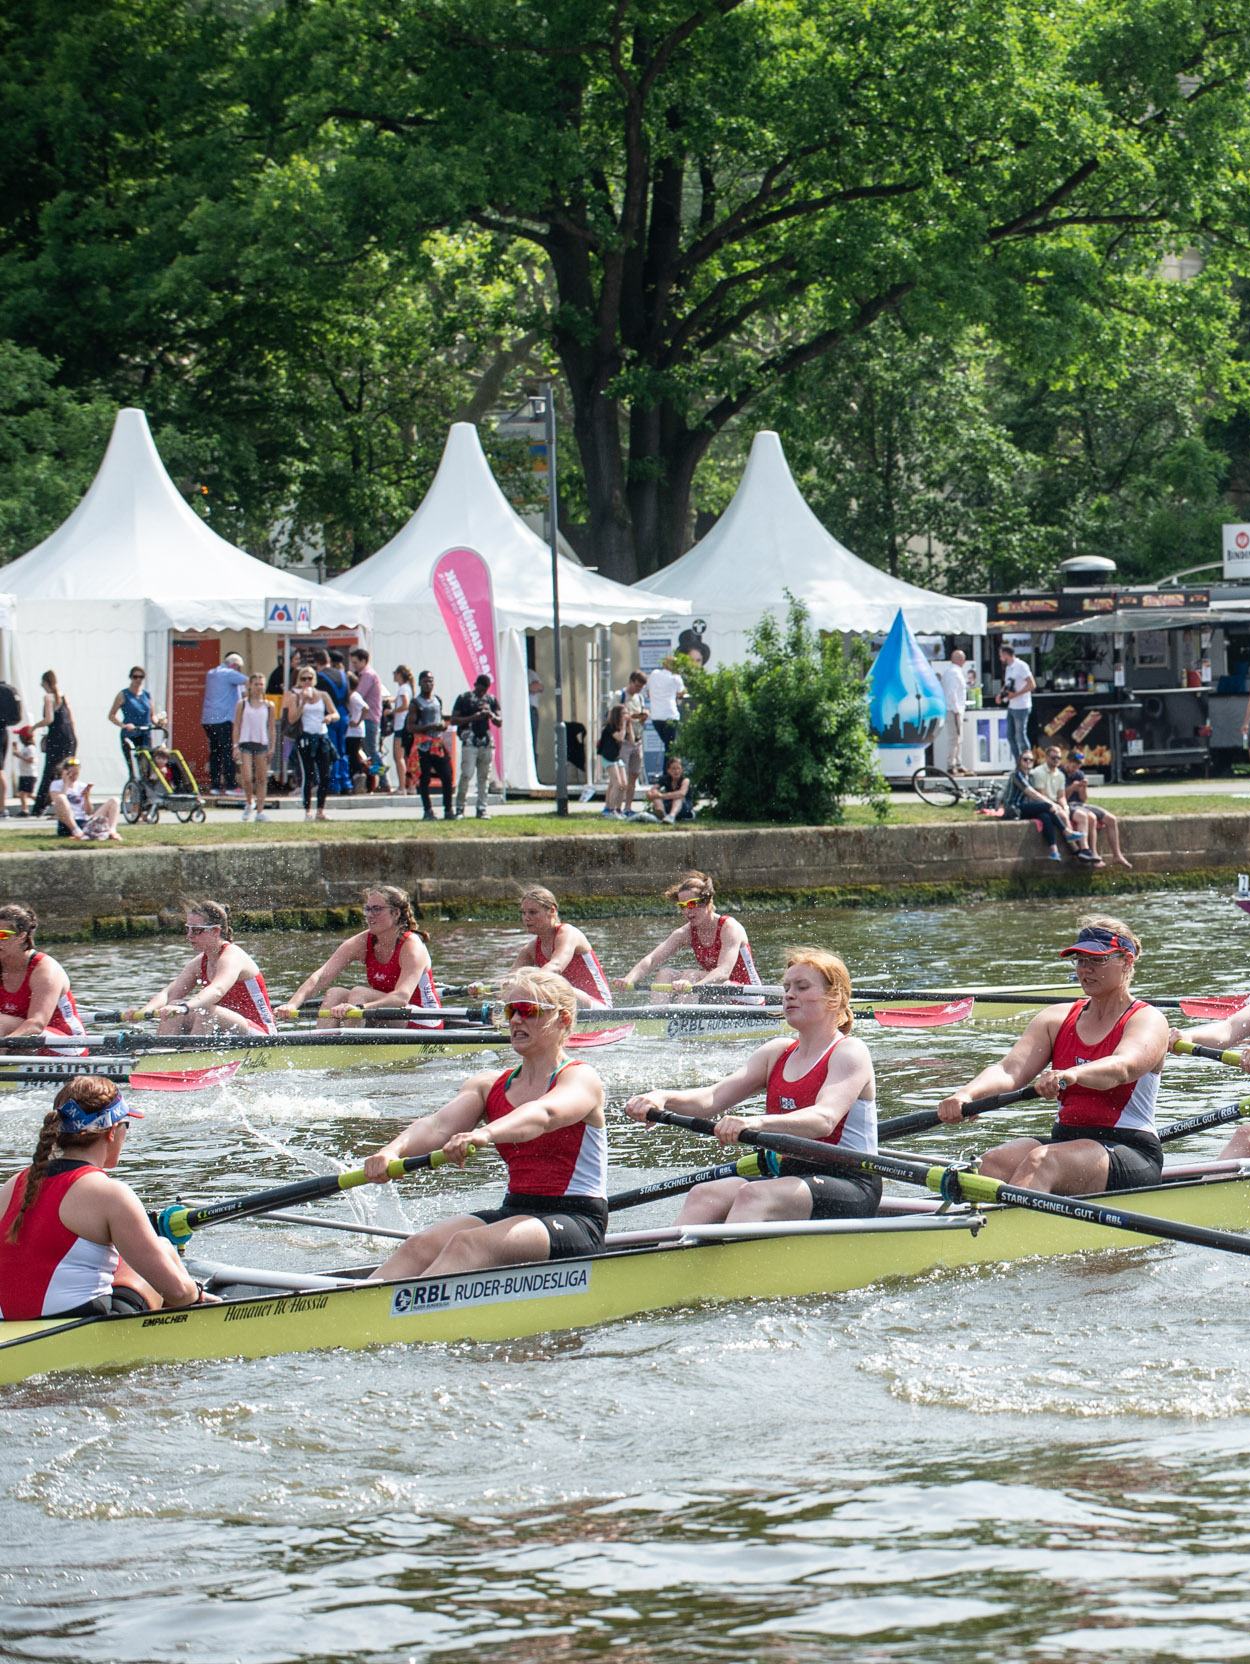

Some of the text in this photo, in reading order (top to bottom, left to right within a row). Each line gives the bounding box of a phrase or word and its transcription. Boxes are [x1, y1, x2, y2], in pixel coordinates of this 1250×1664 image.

[1221, 1106, 1238, 1118] RBL
[1173, 1119, 1203, 1133] SCHNELL.
[1202, 1113, 1217, 1124] GUT.
[719, 1165, 733, 1175] RBL
[873, 1164, 914, 1178] concept 2
[640, 1171, 712, 1195] STARK. SCHNELL. GUT.
[207, 1203, 236, 1216] concept
[1001, 1191, 1095, 1220] STARK. SCHNELL. GUT.
[1105, 1213, 1122, 1225] RBL
[414, 1269, 587, 1305] RBL RUDER-BUNDESLIGA
[223, 1303, 272, 1322] Hanauer
[141, 1314, 188, 1327] EMPACHER
